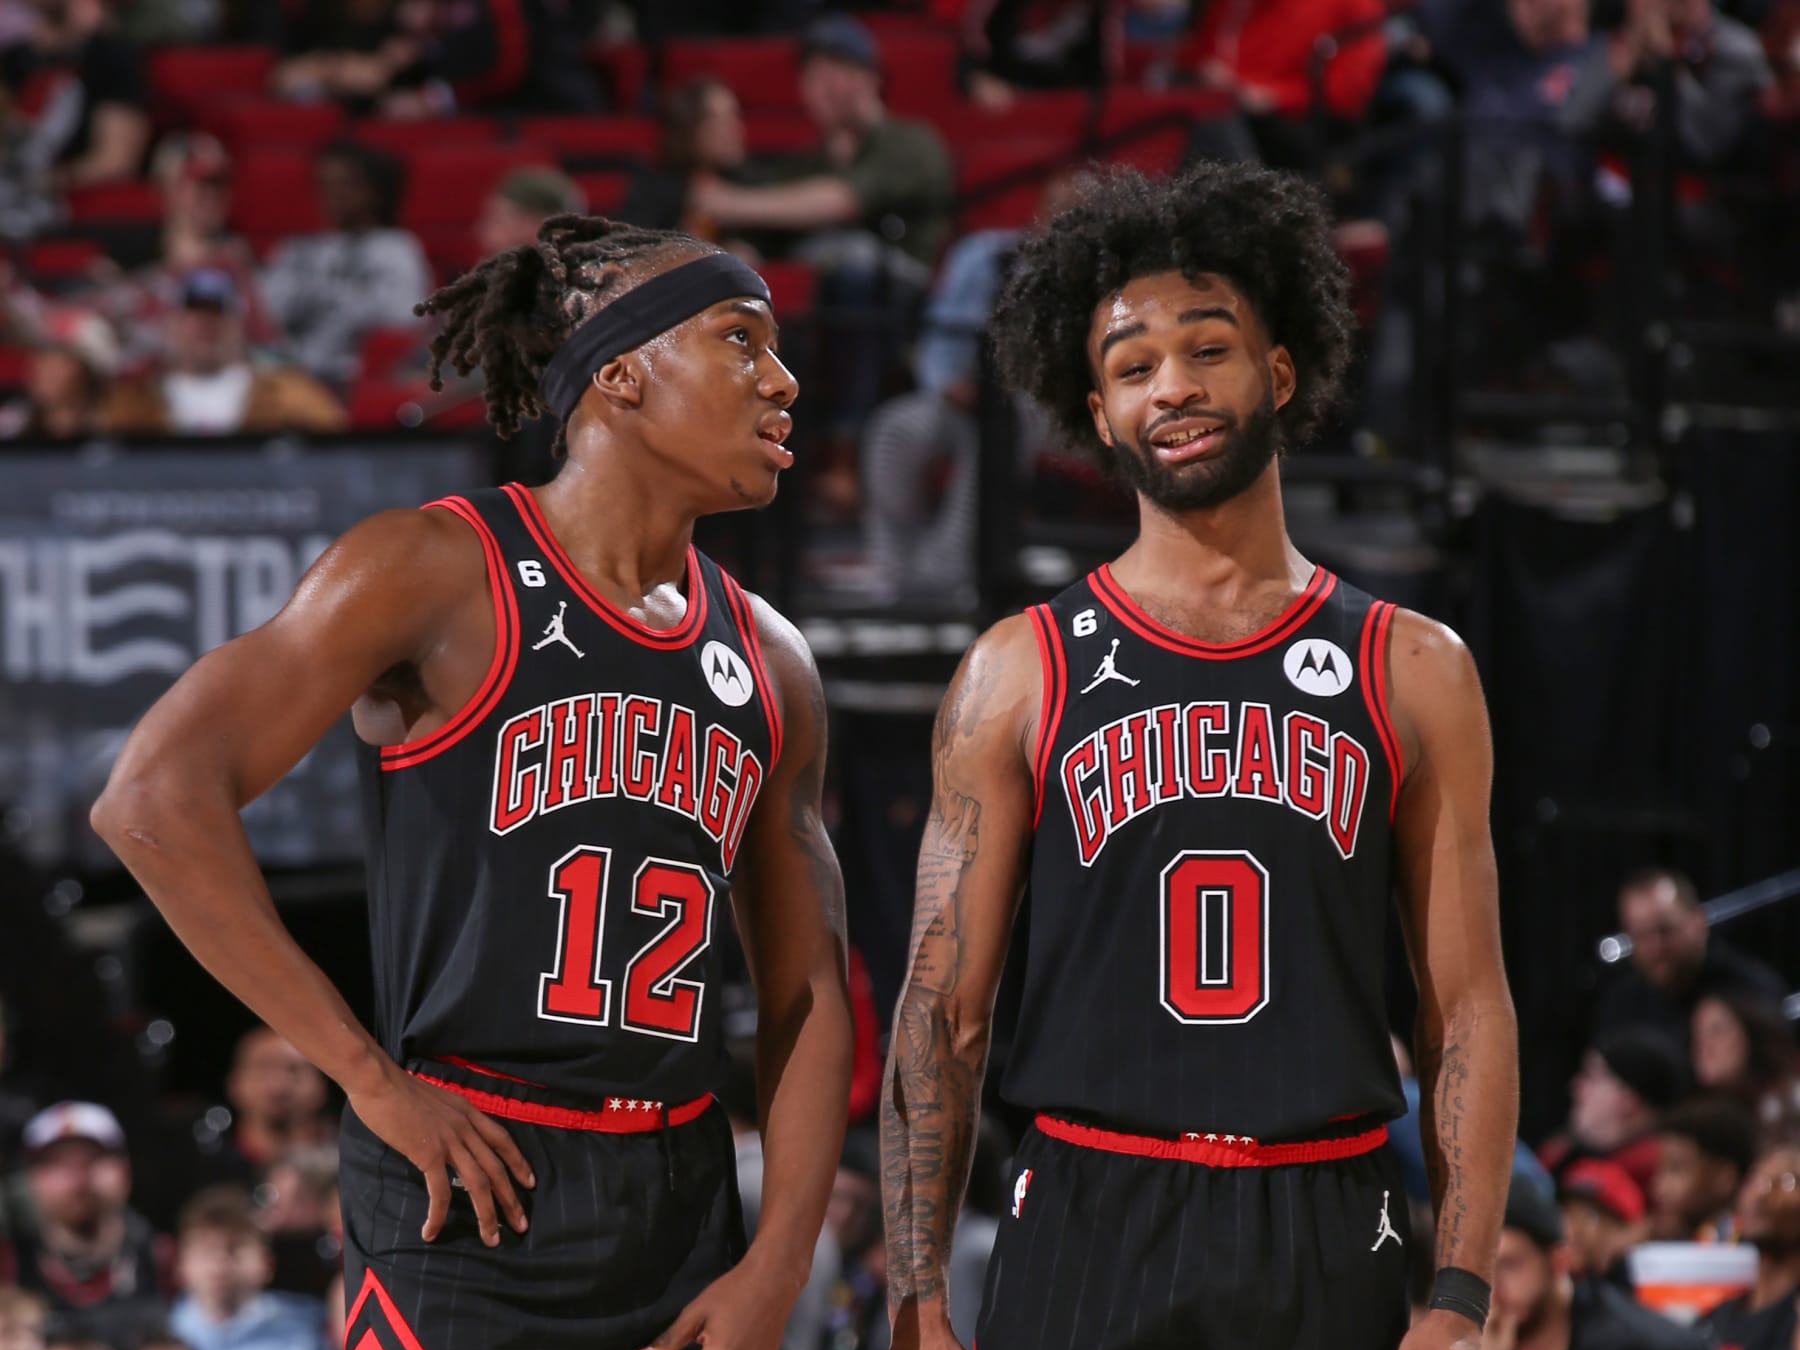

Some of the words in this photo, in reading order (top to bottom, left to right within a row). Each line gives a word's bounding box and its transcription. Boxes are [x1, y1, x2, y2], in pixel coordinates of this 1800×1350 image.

[517, 559, 547, 588] 6
[1072, 608, 1098, 638] 6
[489, 692, 763, 877] CHICAGO
[1060, 701, 1370, 868] CHICAGO
[537, 844, 715, 1043] 12
[1160, 850, 1270, 1025] 0
